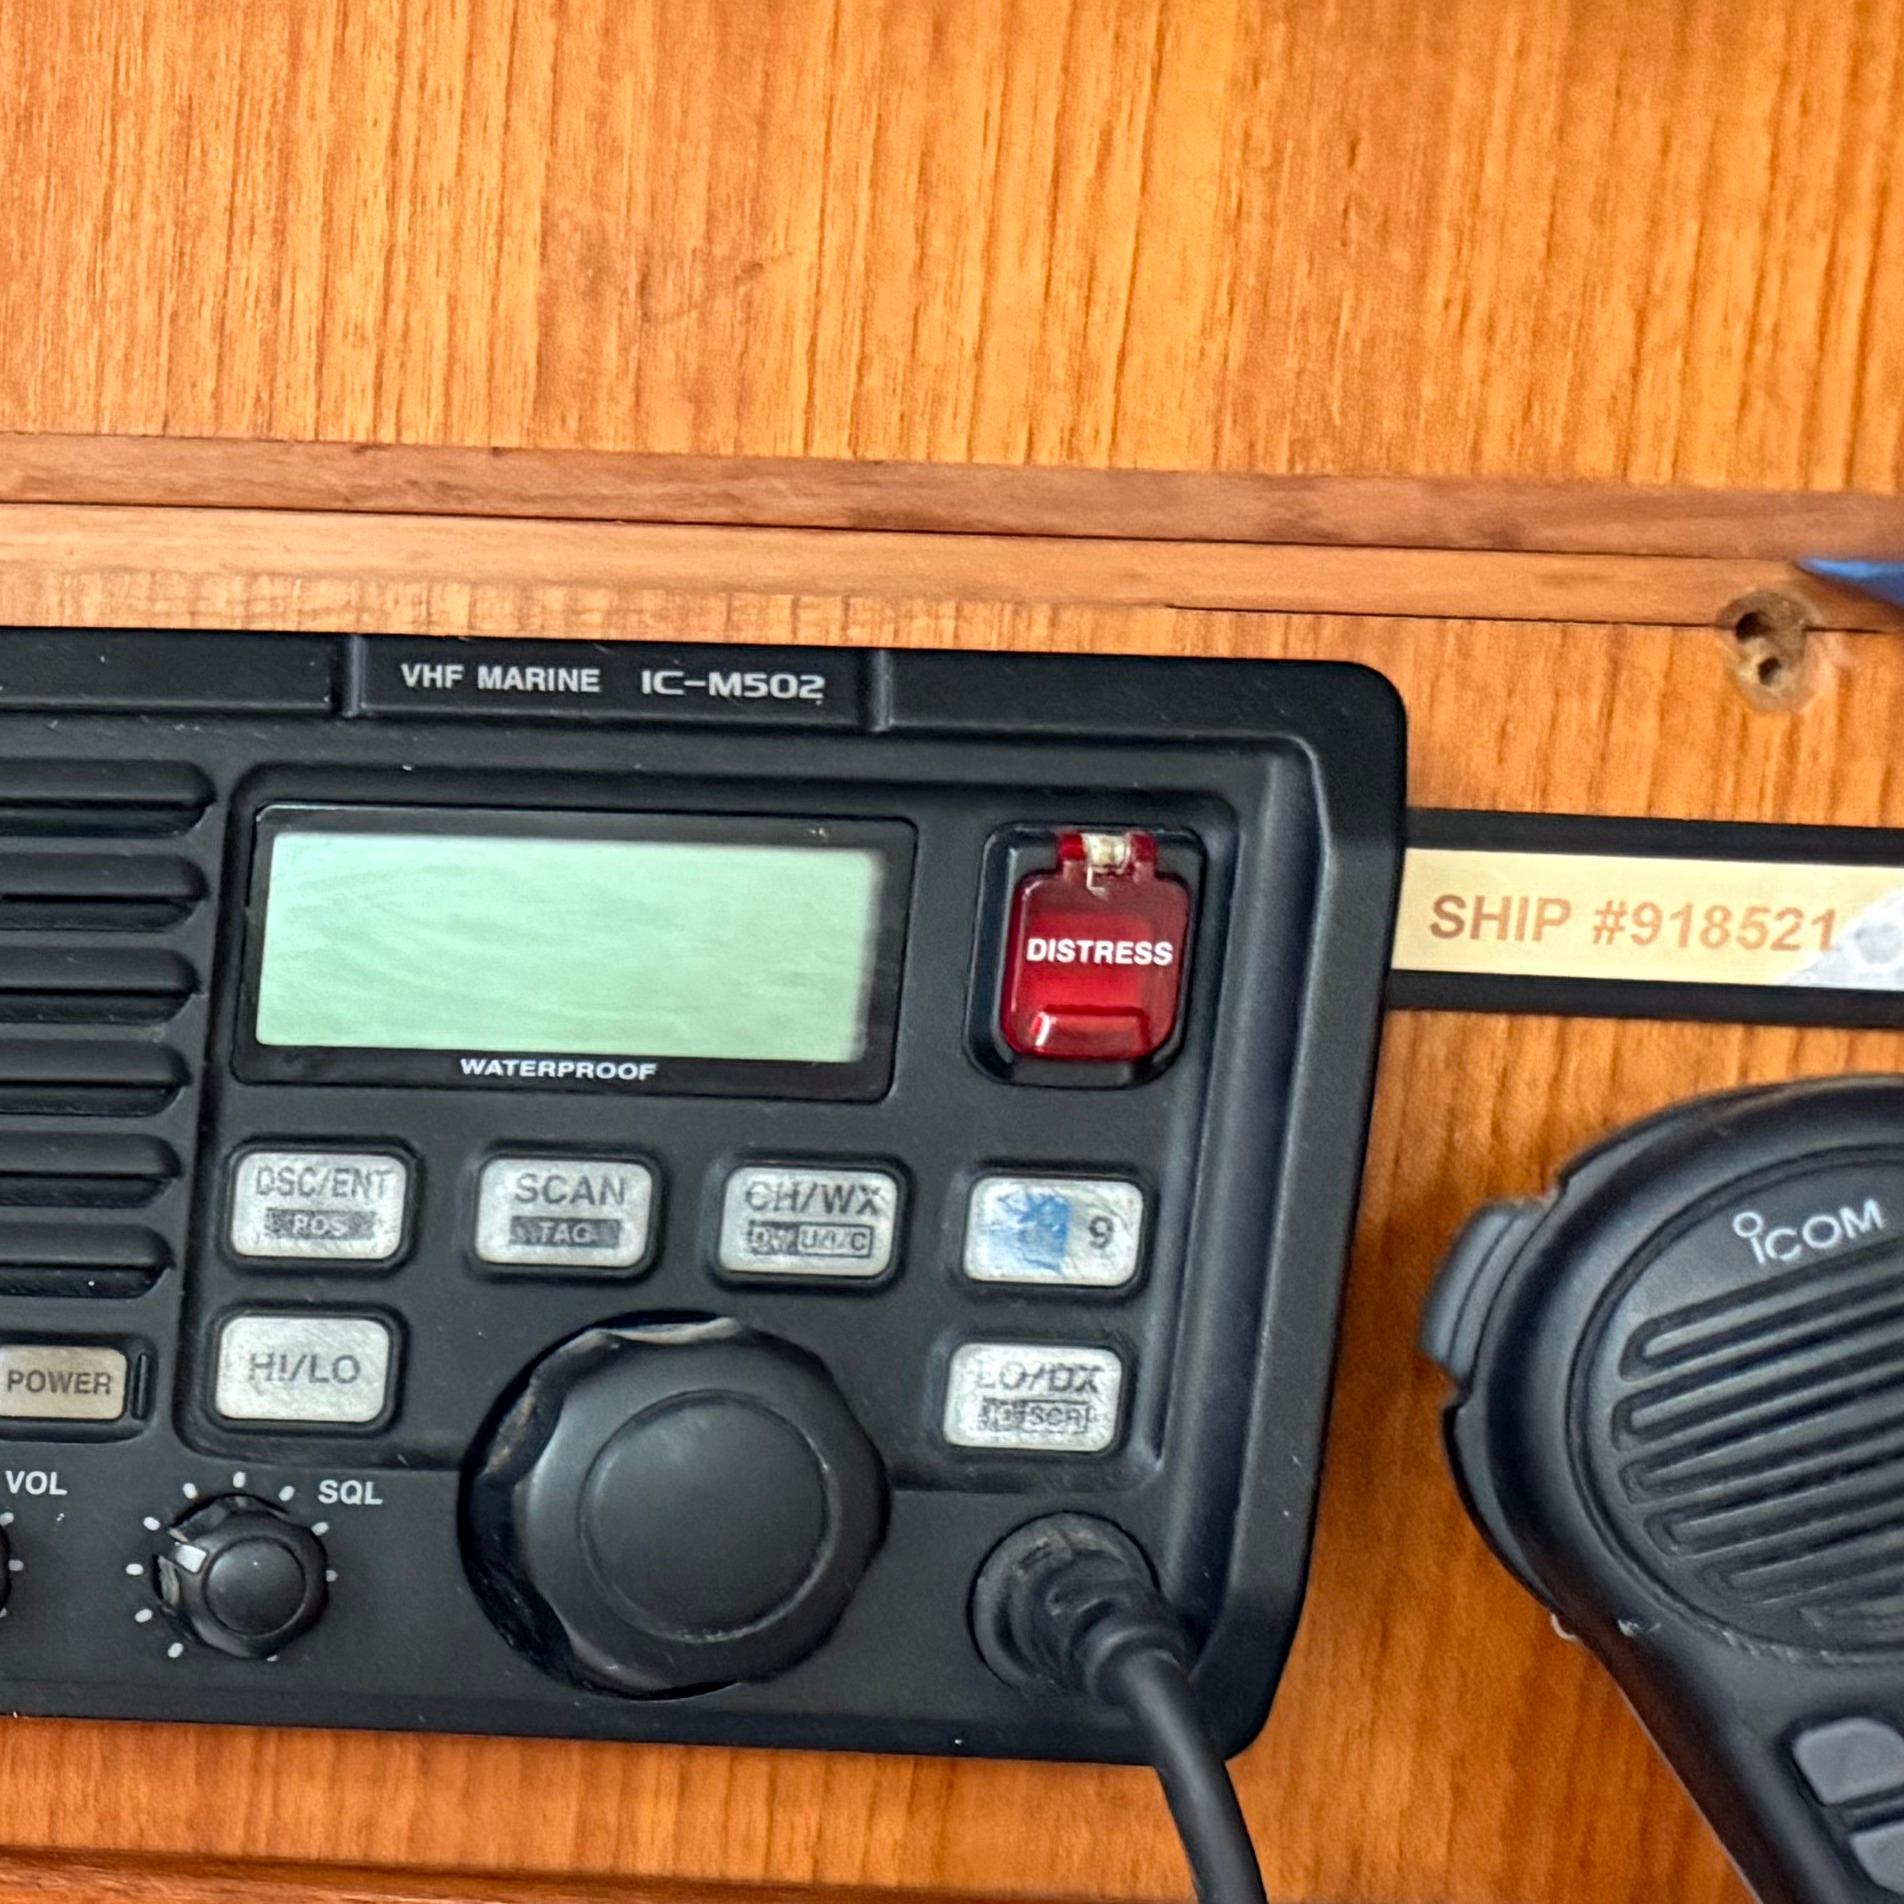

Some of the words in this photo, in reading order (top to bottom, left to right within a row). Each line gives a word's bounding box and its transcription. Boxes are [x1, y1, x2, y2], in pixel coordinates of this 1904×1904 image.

[402, 663, 464, 690] VHF
[478, 664, 602, 694] MARINE
[641, 669, 825, 701] IC-M502
[1428, 893, 1572, 944] SHIP
[1591, 900, 1838, 953] #918521
[1026, 938, 1174, 966] DISTRESS
[460, 1057, 657, 1082] WATERPROOF
[255, 1165, 393, 1199] DSC/ENT
[514, 1172, 626, 1206] SCAN
[745, 1181, 883, 1216] CH/WX
[538, 1221, 593, 1244] TAG
[1088, 1215, 1115, 1249] 9
[6, 1368, 112, 1396] POWER
[247, 1352, 362, 1386] HI/LO
[5, 1470, 68, 1497] VOL
[318, 1480, 383, 1507] SQL
